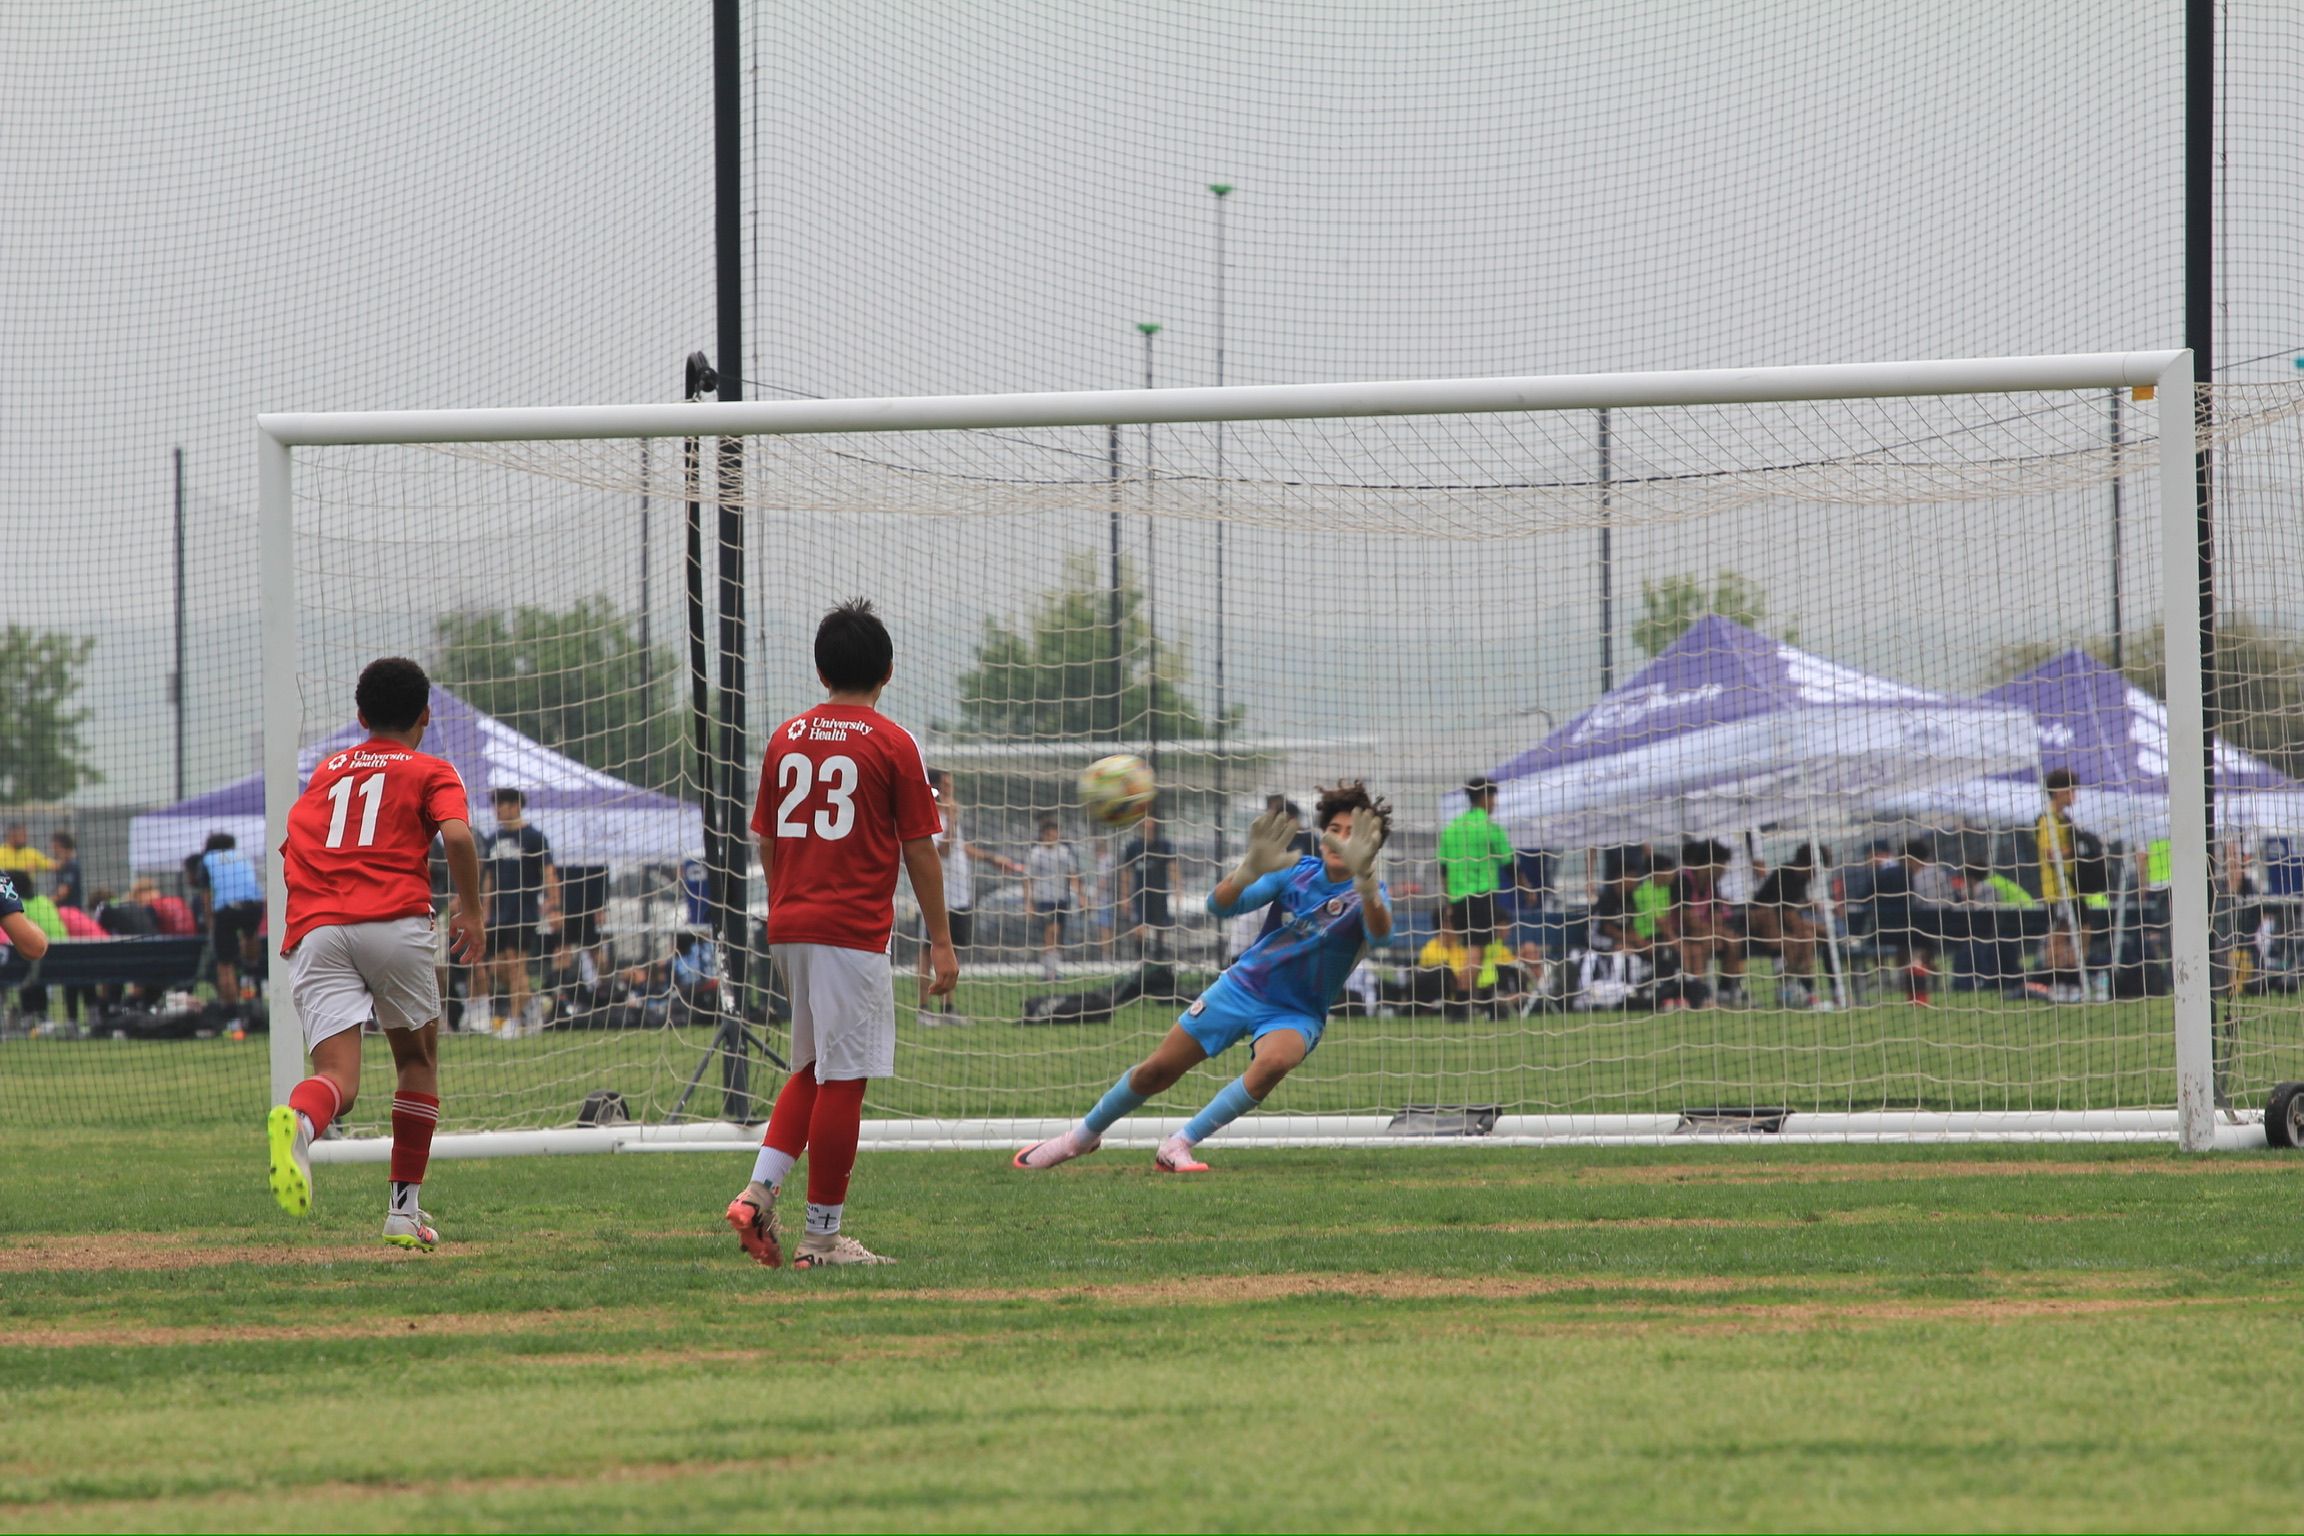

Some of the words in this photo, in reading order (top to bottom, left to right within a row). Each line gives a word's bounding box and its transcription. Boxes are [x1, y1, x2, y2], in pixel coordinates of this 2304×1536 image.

[808, 727, 848, 742] Health
[812, 717, 874, 736] University
[353, 750, 414, 761] University
[348, 760, 388, 769] Health
[776, 752, 859, 841] 23
[325, 772, 386, 849] 11
